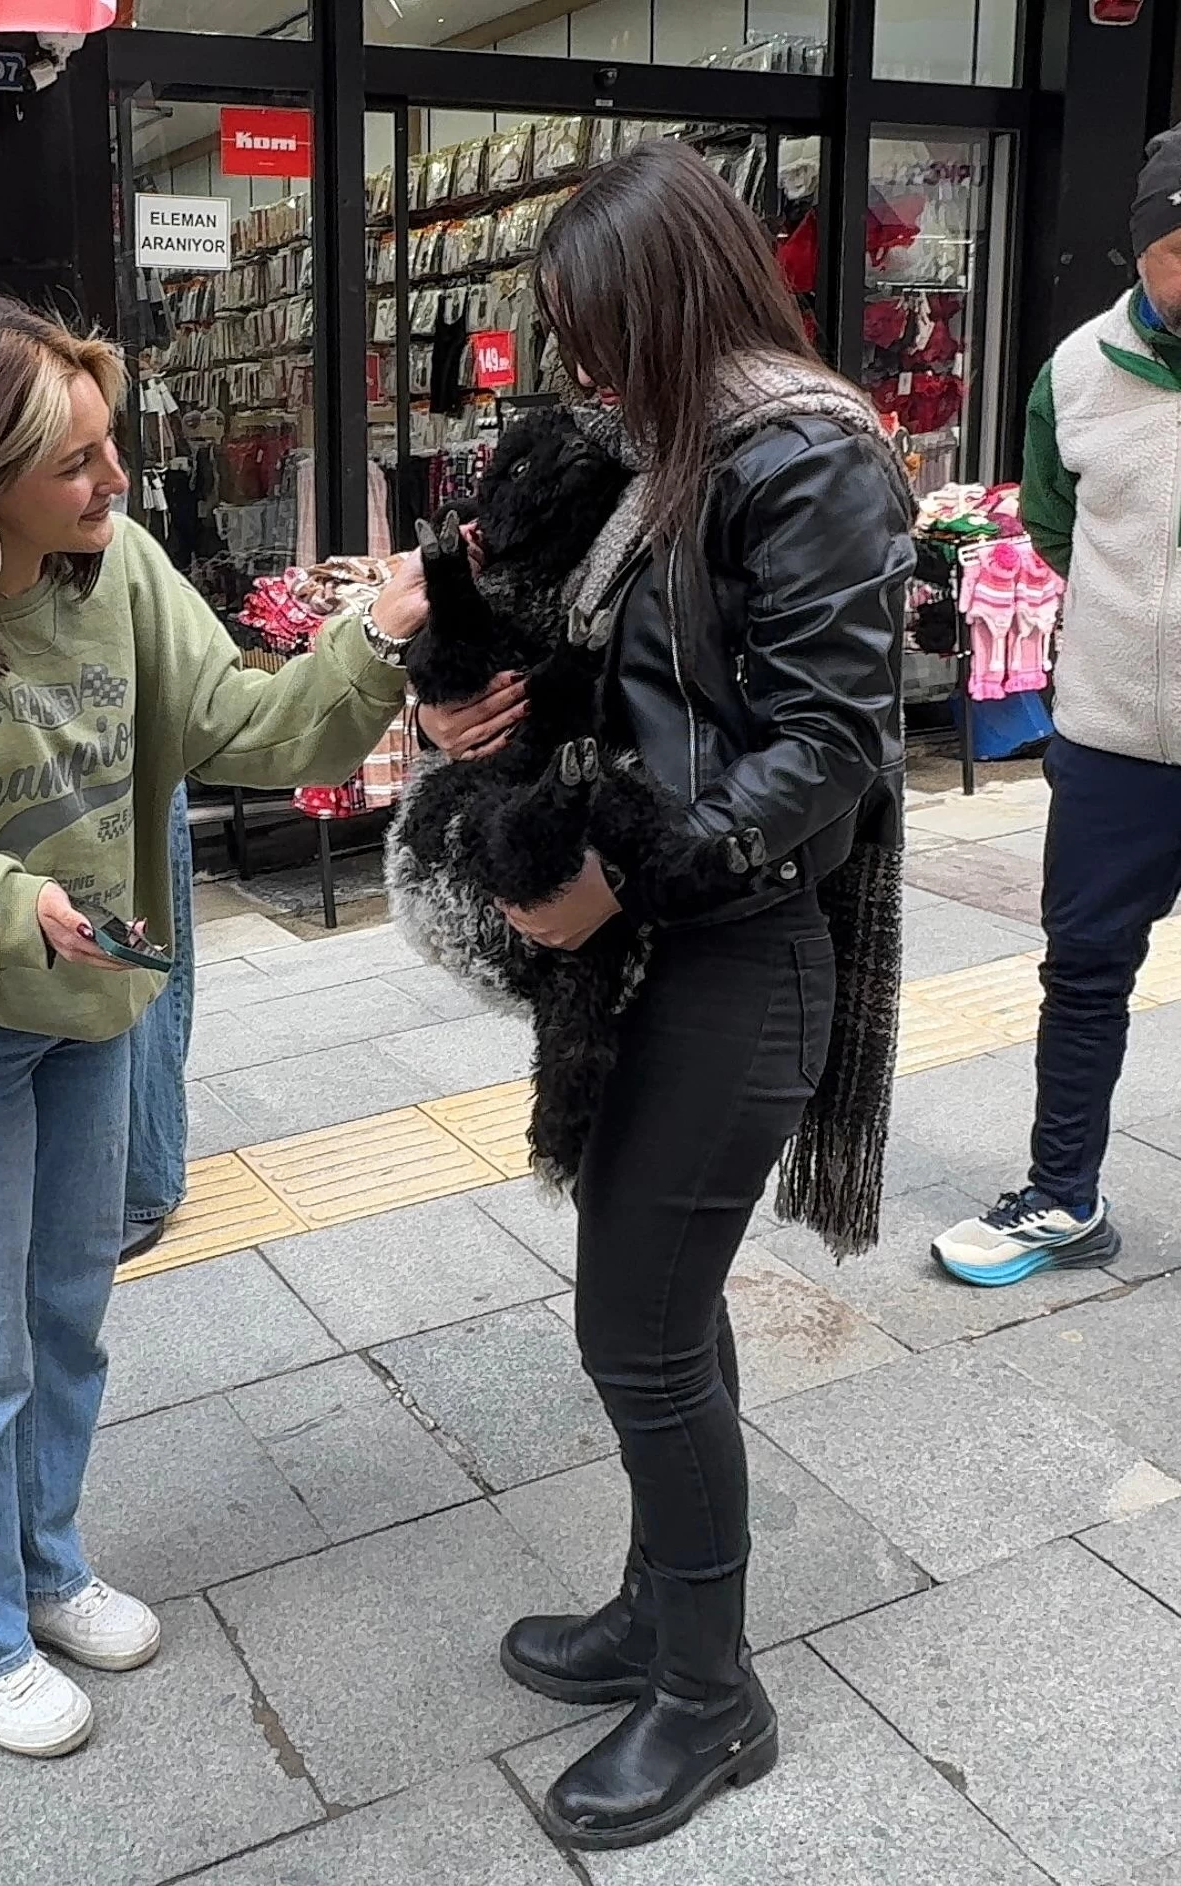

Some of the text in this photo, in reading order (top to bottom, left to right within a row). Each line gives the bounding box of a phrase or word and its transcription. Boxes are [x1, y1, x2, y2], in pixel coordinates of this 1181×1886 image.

[235, 131, 297, 151] Kom
[150, 211, 217, 228] ELEMAN
[141, 236, 226, 253] ARANIYOR
